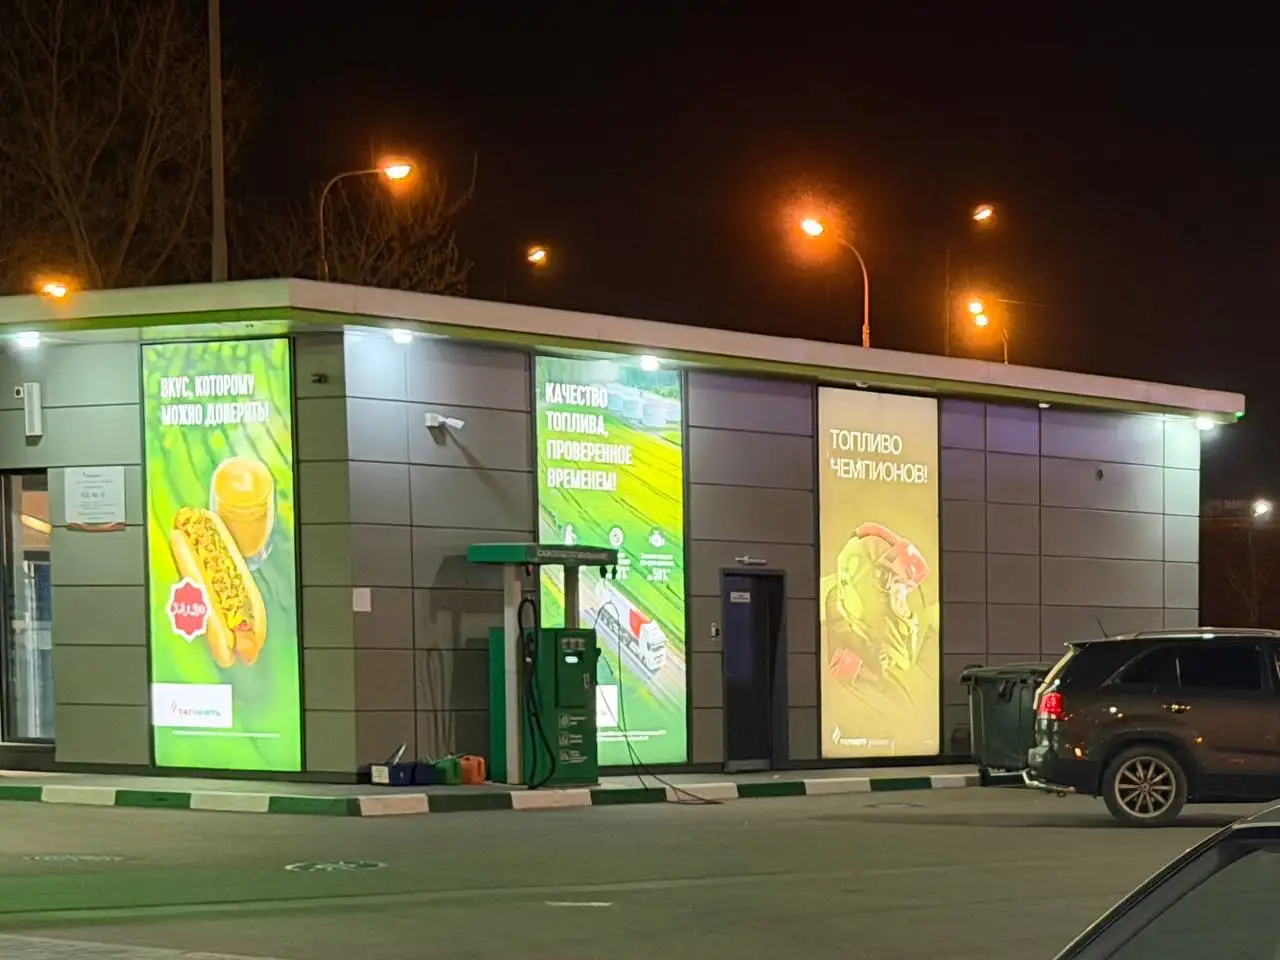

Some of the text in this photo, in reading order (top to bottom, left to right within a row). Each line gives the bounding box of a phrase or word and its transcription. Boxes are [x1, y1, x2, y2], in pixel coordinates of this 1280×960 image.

[160, 373, 254, 400] ВКУС, КОТОРОМУ
[545, 381, 609, 409] КАЧЕСТВО
[161, 403, 203, 426] МОЖНО
[545, 410, 610, 438] ТОПЛИВА,
[546, 439, 633, 465] ПРОВЕРЕННОЕ
[829, 428, 903, 455] ТОПЛИВО
[547, 467, 618, 491] ВРЕМЕНЕМ!
[829, 456, 928, 484] ЧЕМПИОНОВ!
